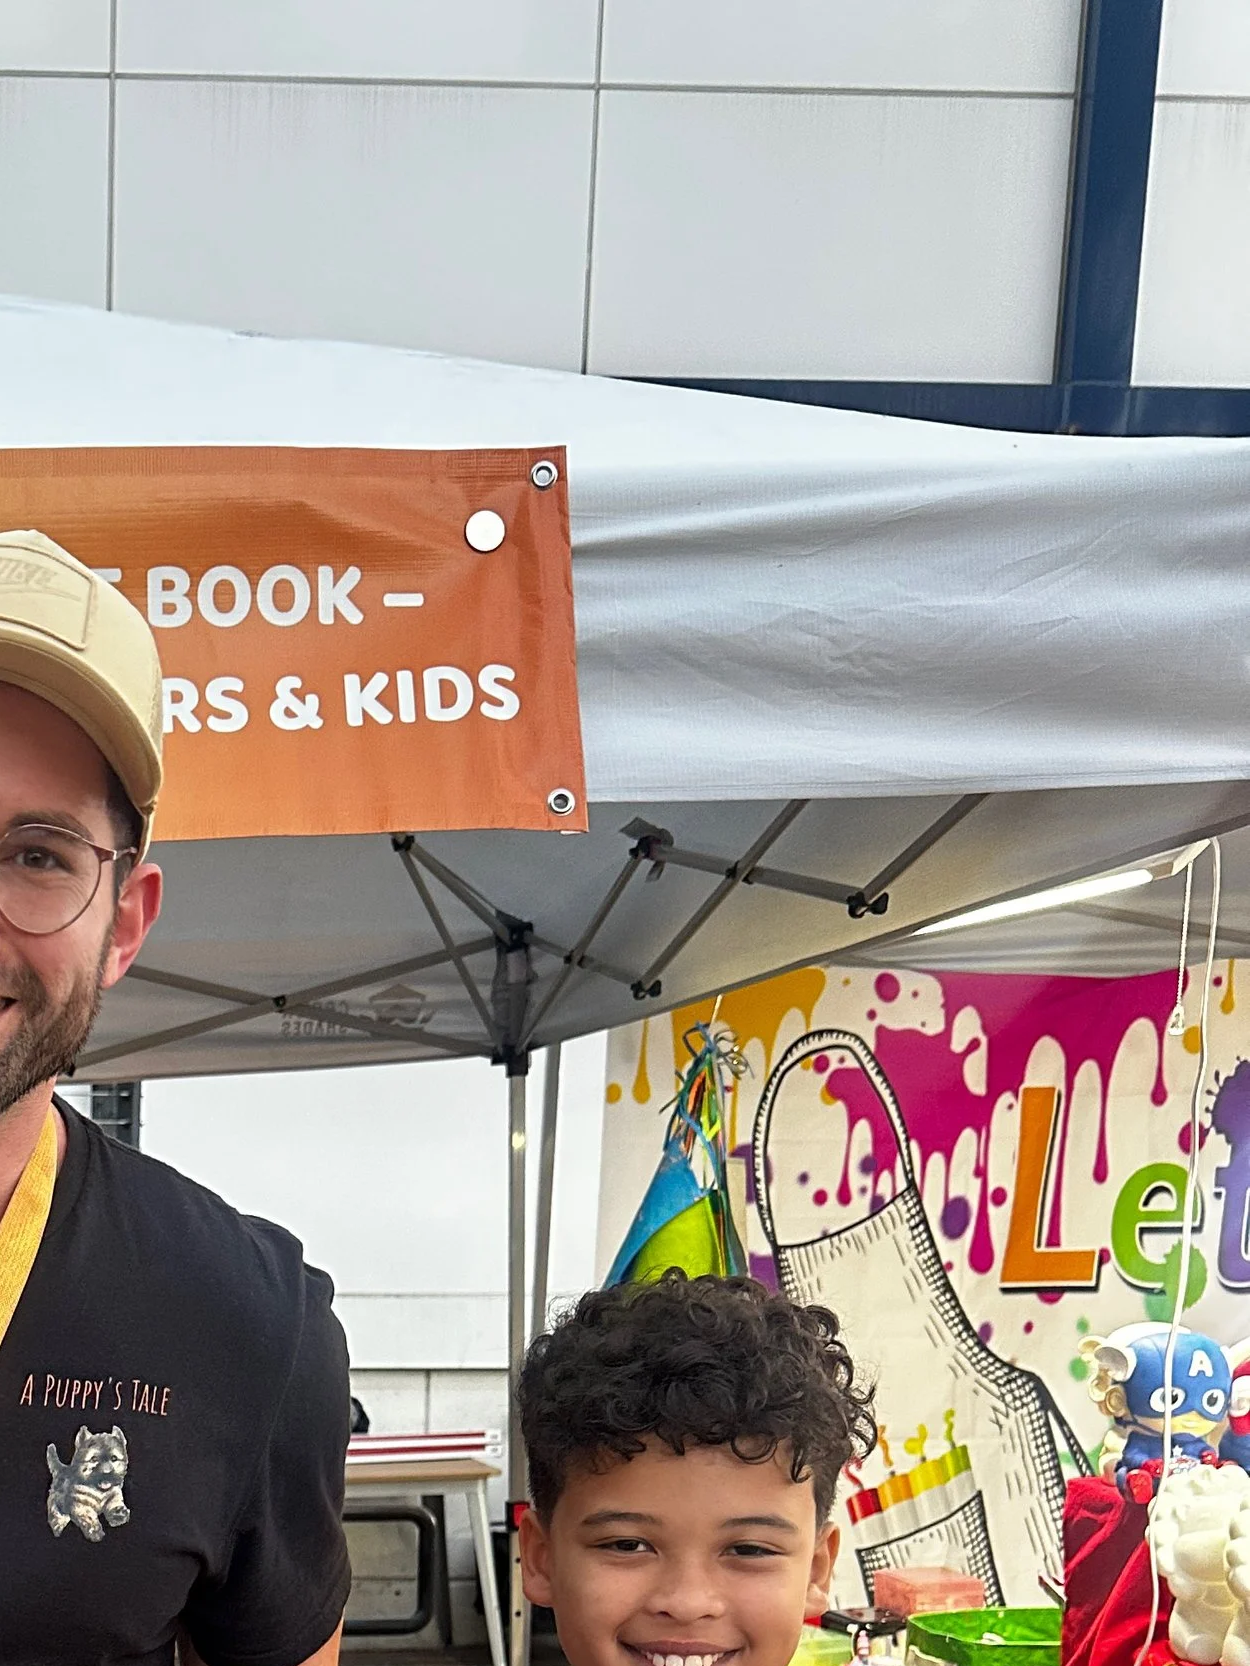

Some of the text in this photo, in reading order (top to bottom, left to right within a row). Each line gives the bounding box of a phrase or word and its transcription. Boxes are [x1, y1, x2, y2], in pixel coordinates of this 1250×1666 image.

[147, 564, 364, 628] BOOK
[269, 675, 324, 731] &
[344, 664, 520, 727] KIDS
[19, 1373, 171, 1416] A PUPPY'S TALE
